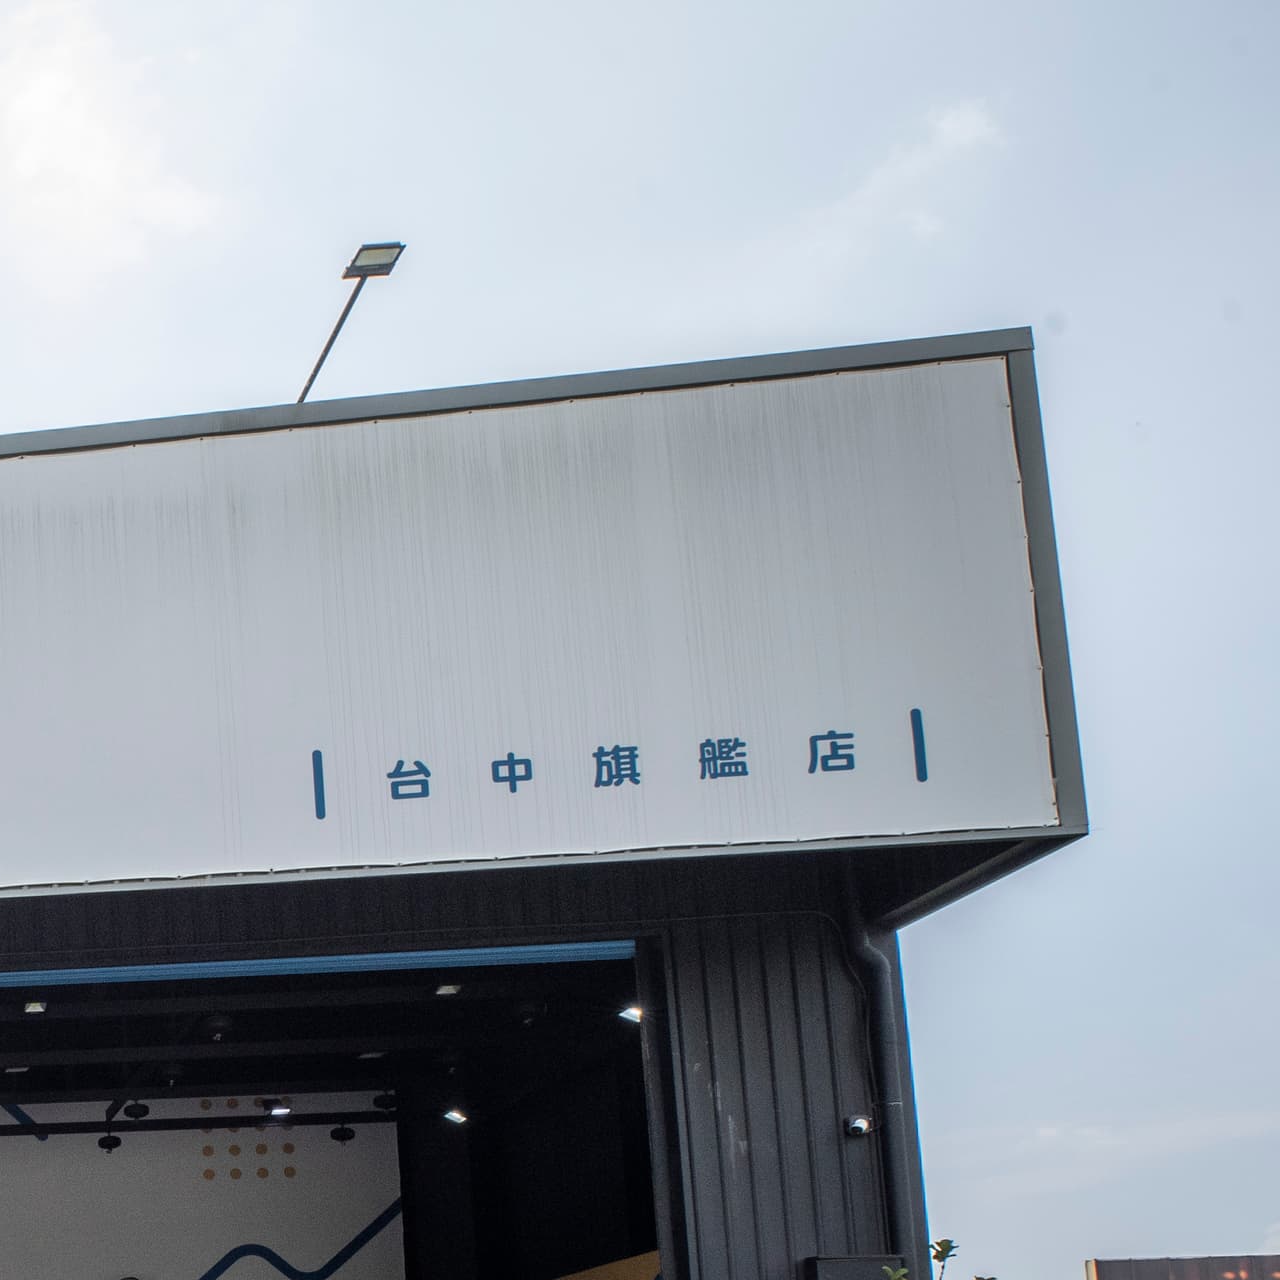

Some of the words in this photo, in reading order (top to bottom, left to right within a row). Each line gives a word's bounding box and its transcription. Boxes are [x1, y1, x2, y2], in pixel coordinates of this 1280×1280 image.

[386, 729, 855, 801] 台中旗艦店
